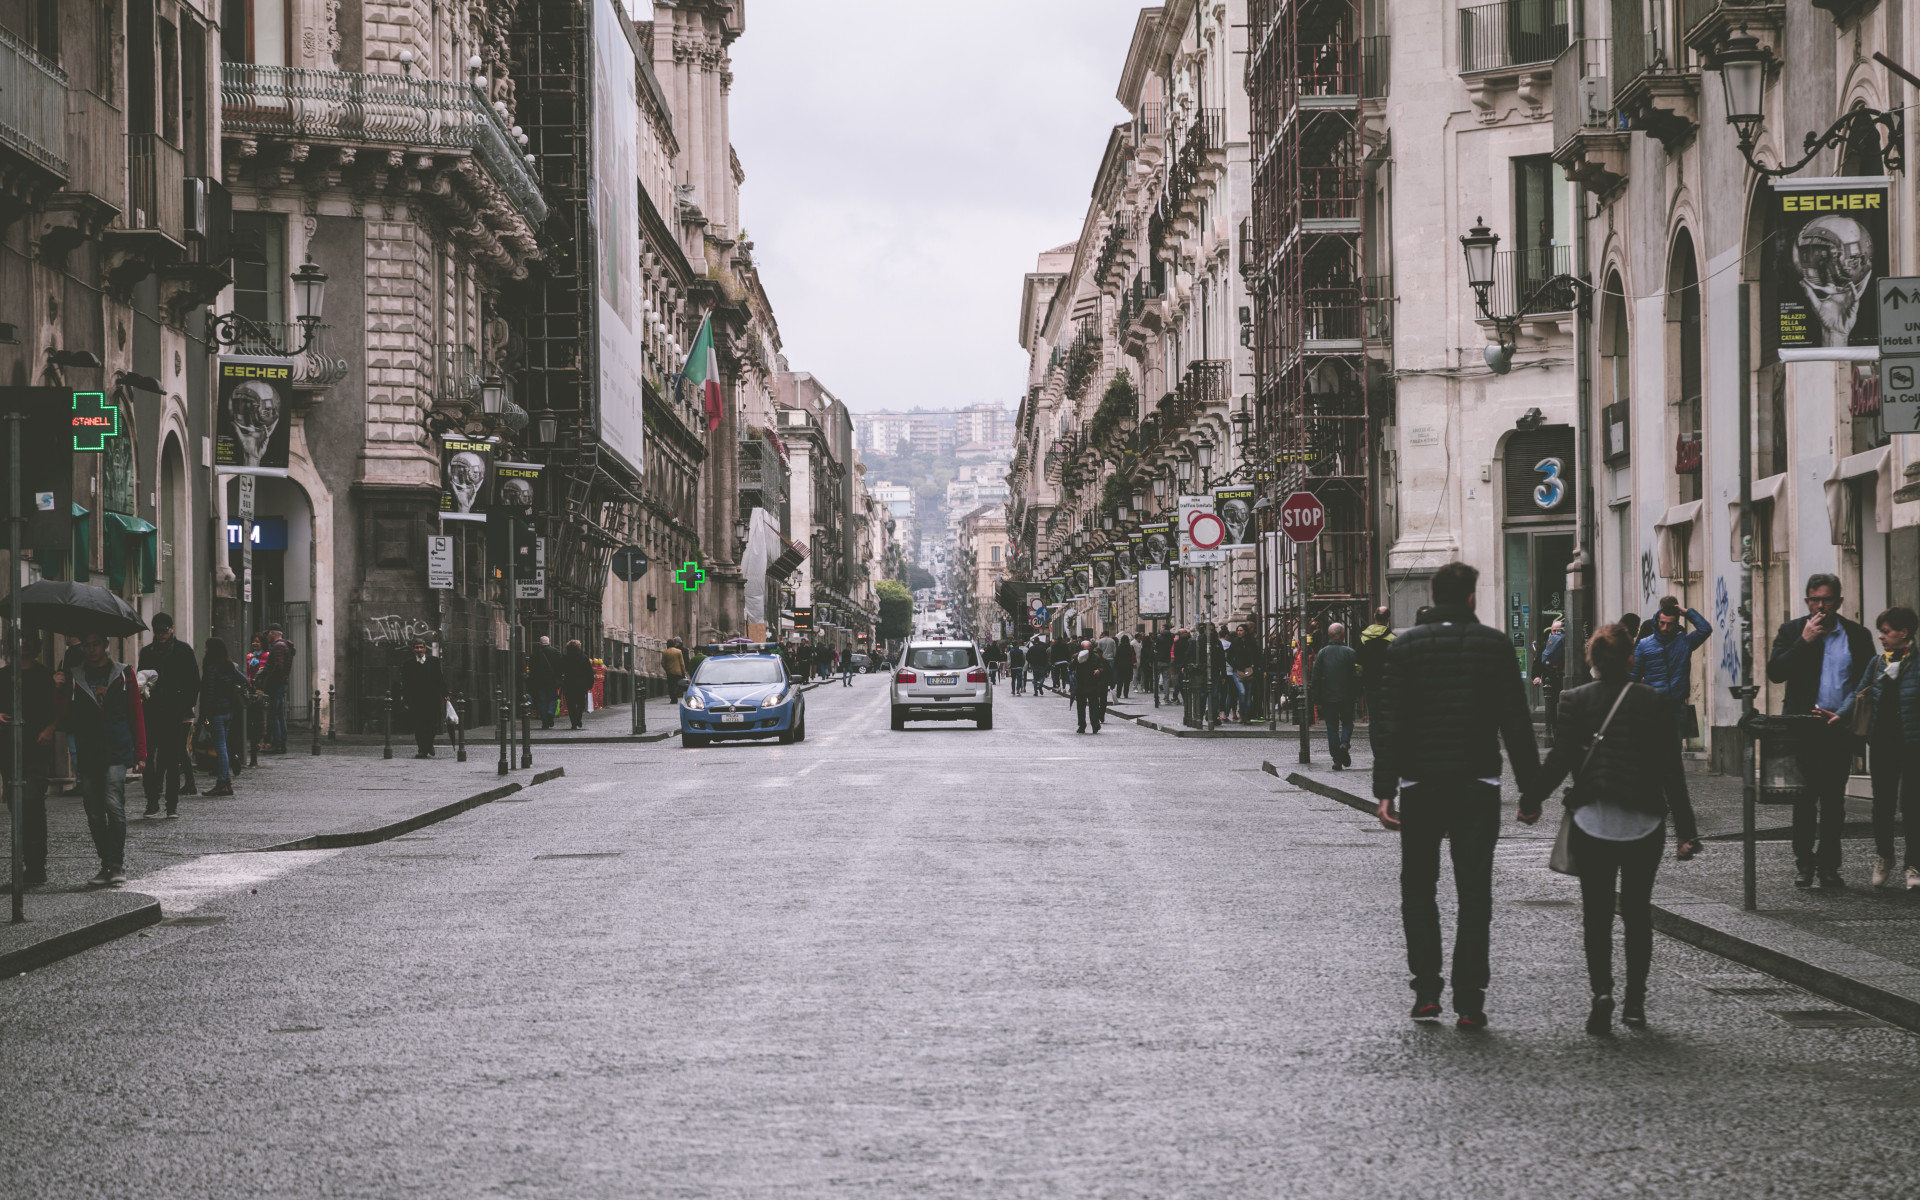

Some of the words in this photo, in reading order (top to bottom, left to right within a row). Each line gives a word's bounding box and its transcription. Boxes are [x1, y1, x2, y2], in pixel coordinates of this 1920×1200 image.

[1783, 194, 1880, 211] ESCHER
[1884, 336, 1913, 346] Hotel
[224, 366, 288, 379] ESCHER
[1884, 394, 1896, 403] La
[445, 441, 491, 452] ESCHER
[499, 469, 539, 478] ESCHER
[1534, 457, 1565, 508] 3
[1218, 491, 1252, 499] ESCHER
[1284, 507, 1322, 527] STOP
